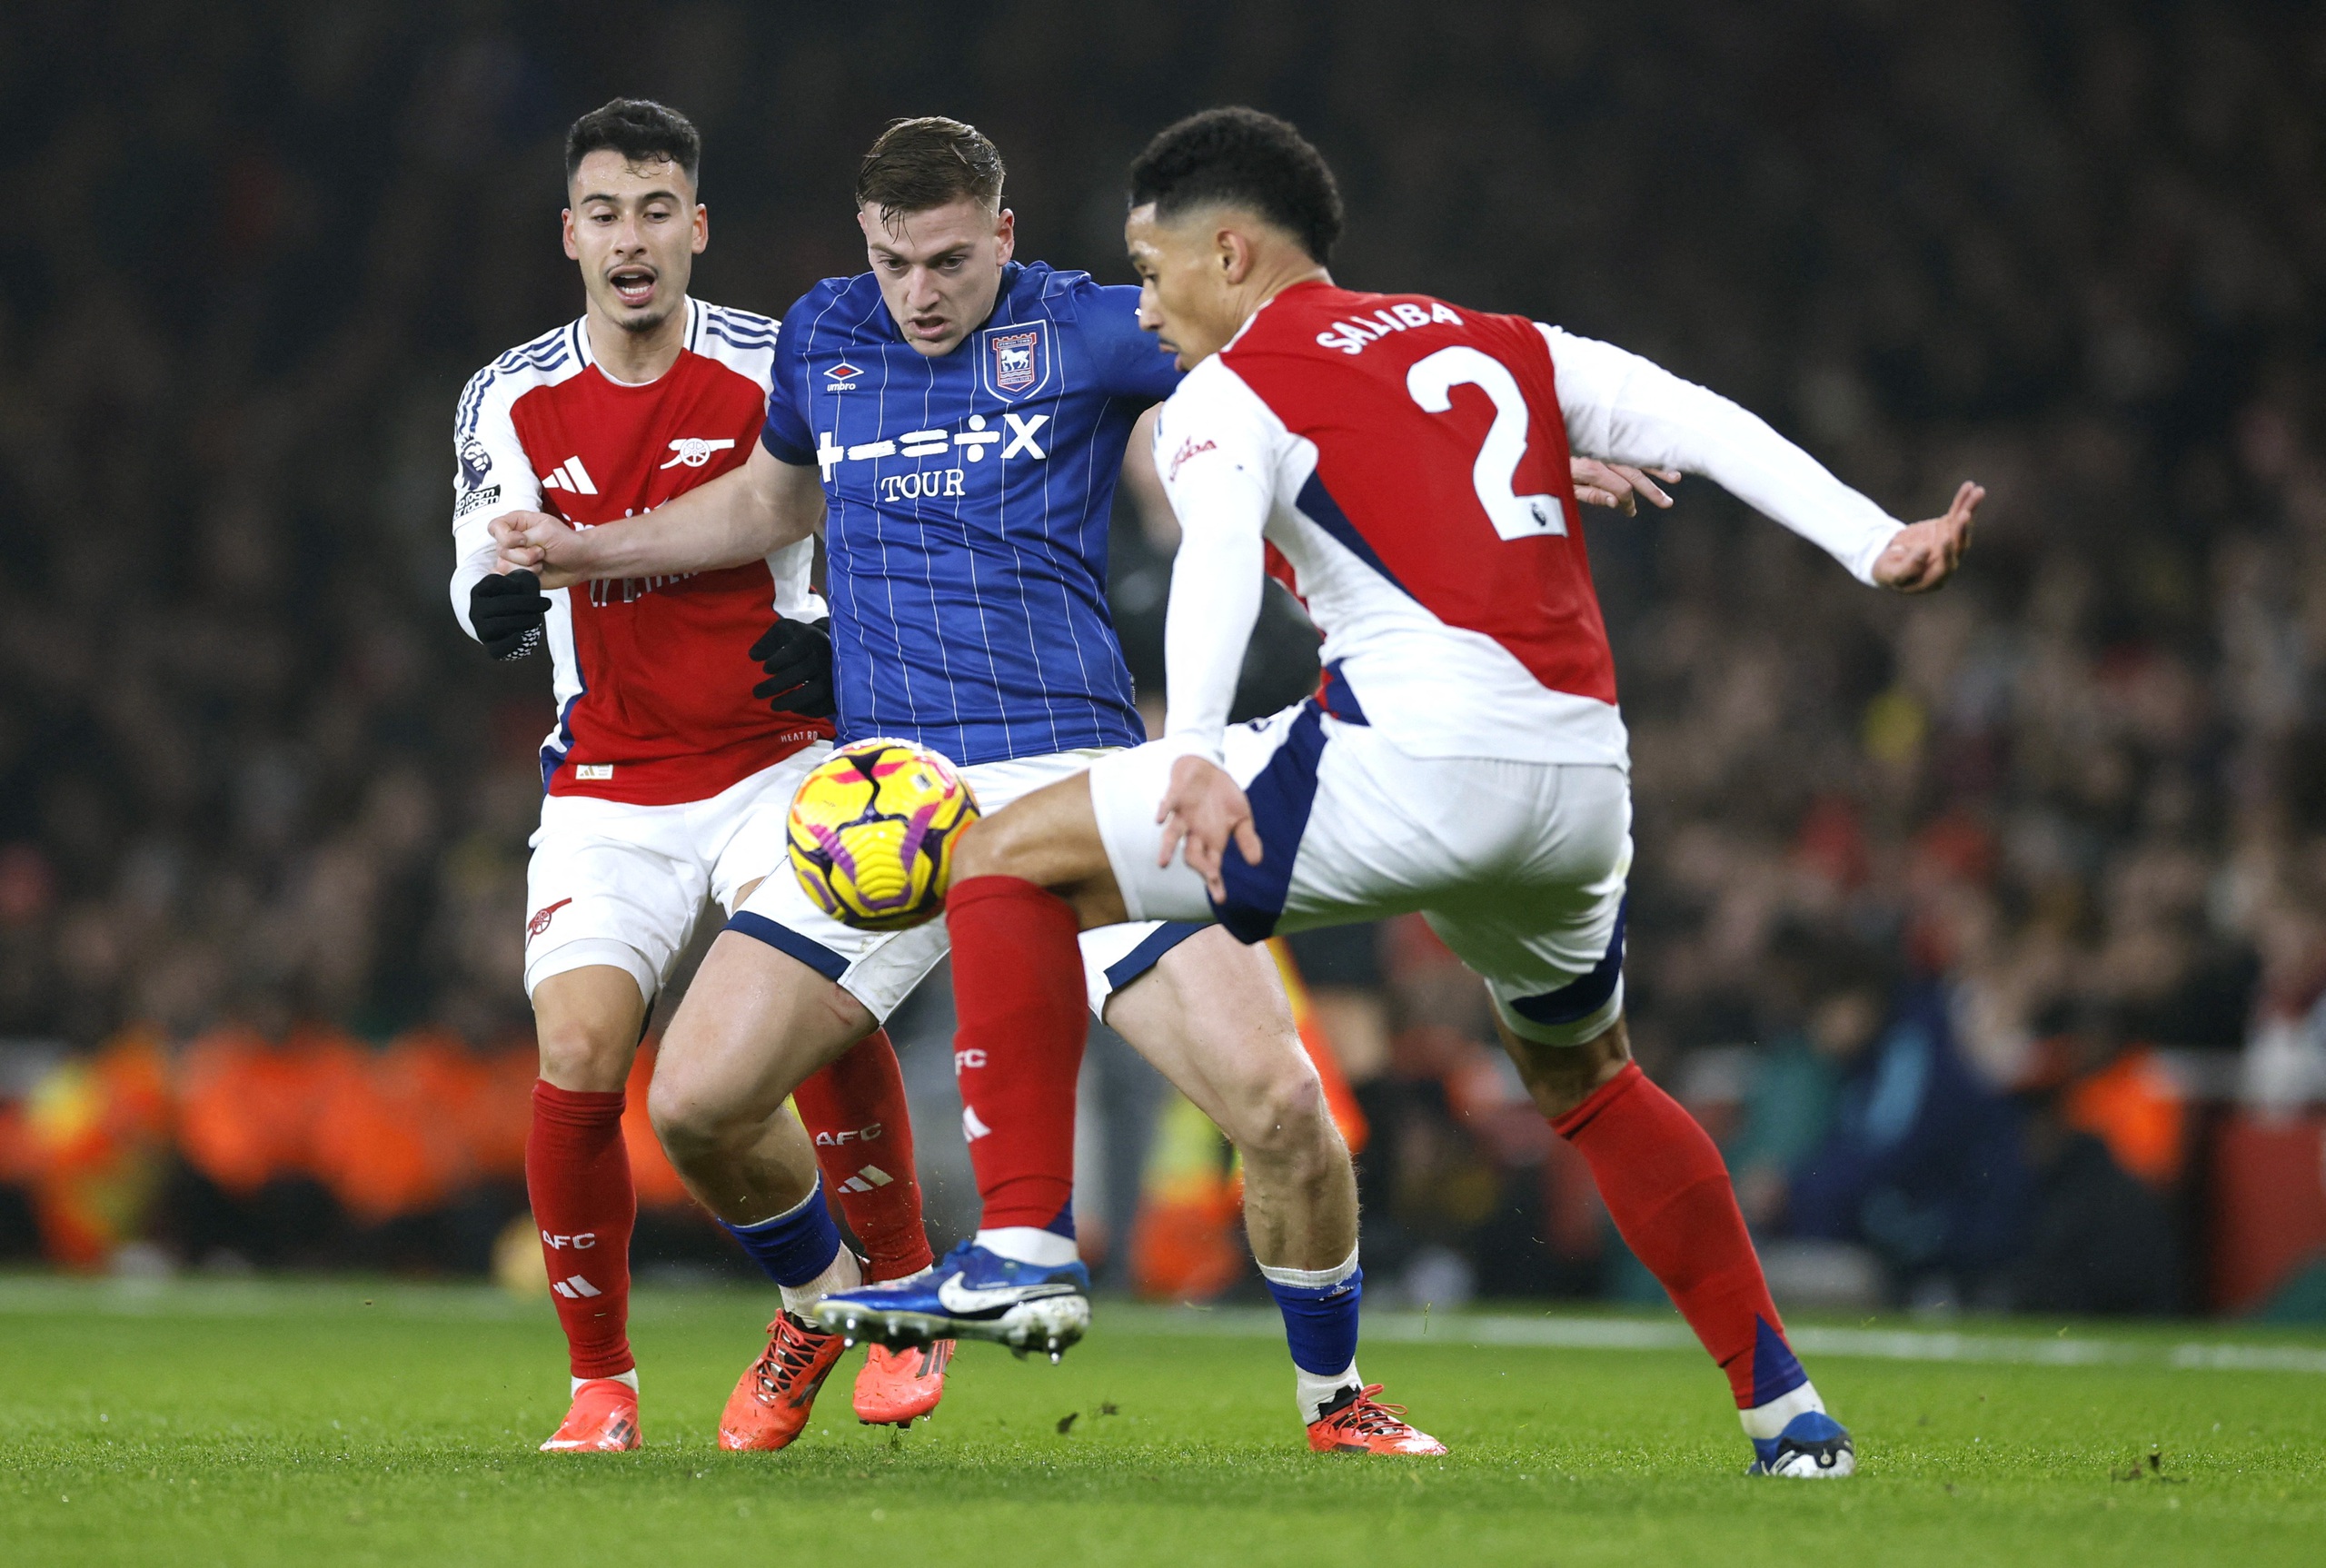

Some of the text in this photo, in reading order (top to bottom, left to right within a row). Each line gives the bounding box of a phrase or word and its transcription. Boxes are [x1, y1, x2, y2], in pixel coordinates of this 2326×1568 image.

[1316, 303, 1465, 355] SALIBA
[827, 382, 856, 392] umbro
[1406, 345, 1568, 541] 2
[880, 468, 966, 502] TOUR
[780, 730, 819, 743] HEAT.RD
[955, 1047, 988, 1077] FC
[816, 1123, 881, 1146] AFC
[542, 1229, 596, 1250] AFC
